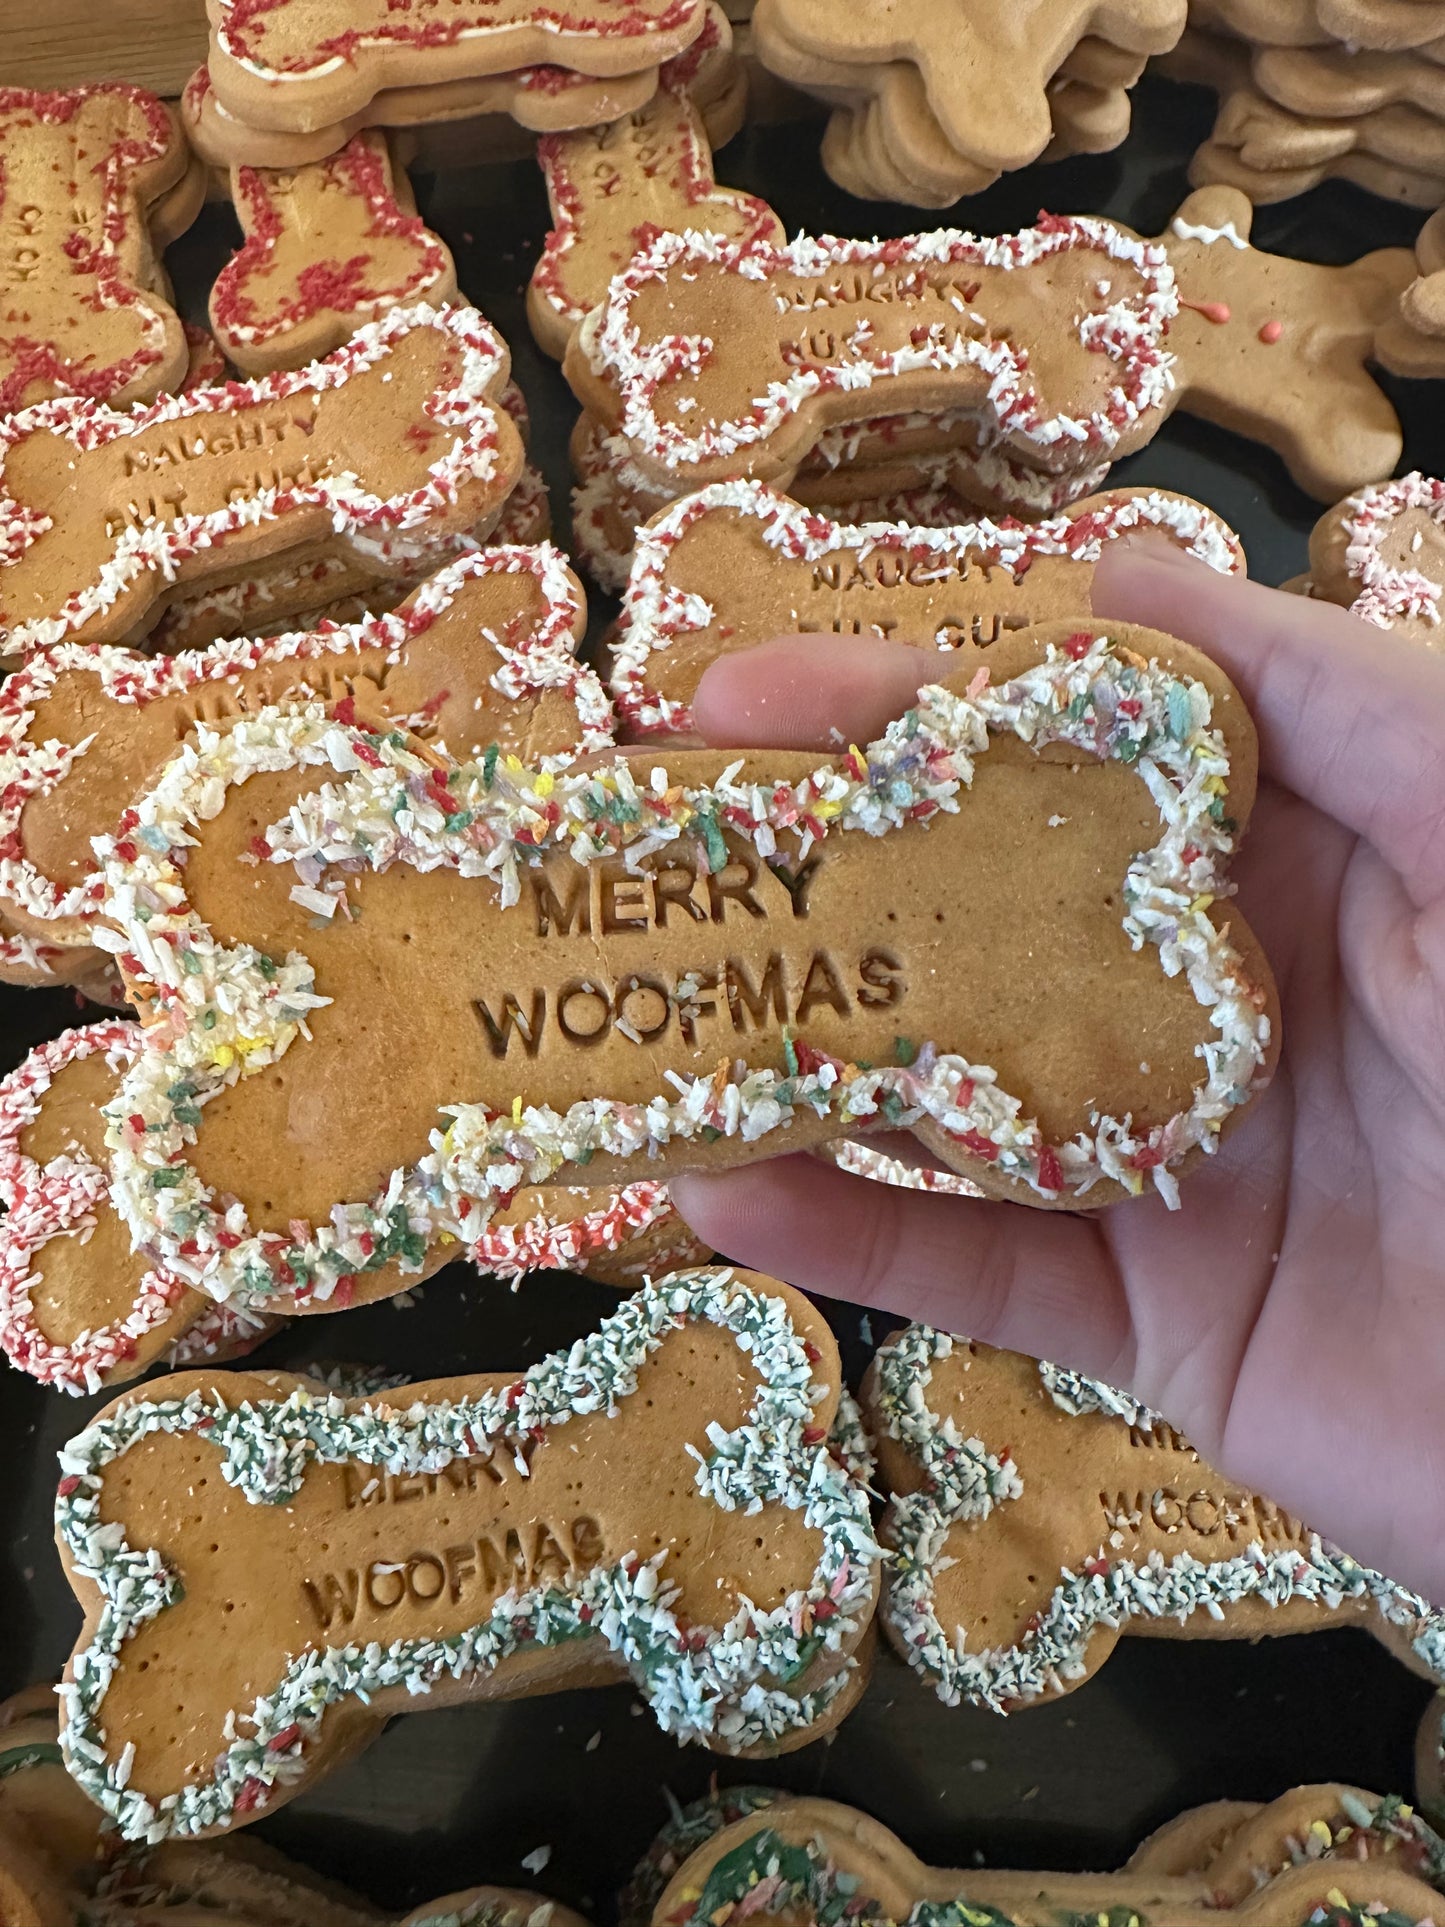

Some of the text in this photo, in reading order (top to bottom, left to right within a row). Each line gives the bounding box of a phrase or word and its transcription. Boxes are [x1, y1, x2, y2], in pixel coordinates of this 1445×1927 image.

[124, 410, 319, 478] NAUGHTY
[529, 854, 826, 938] MERRY
[471, 944, 906, 1060] WOOFMAS
